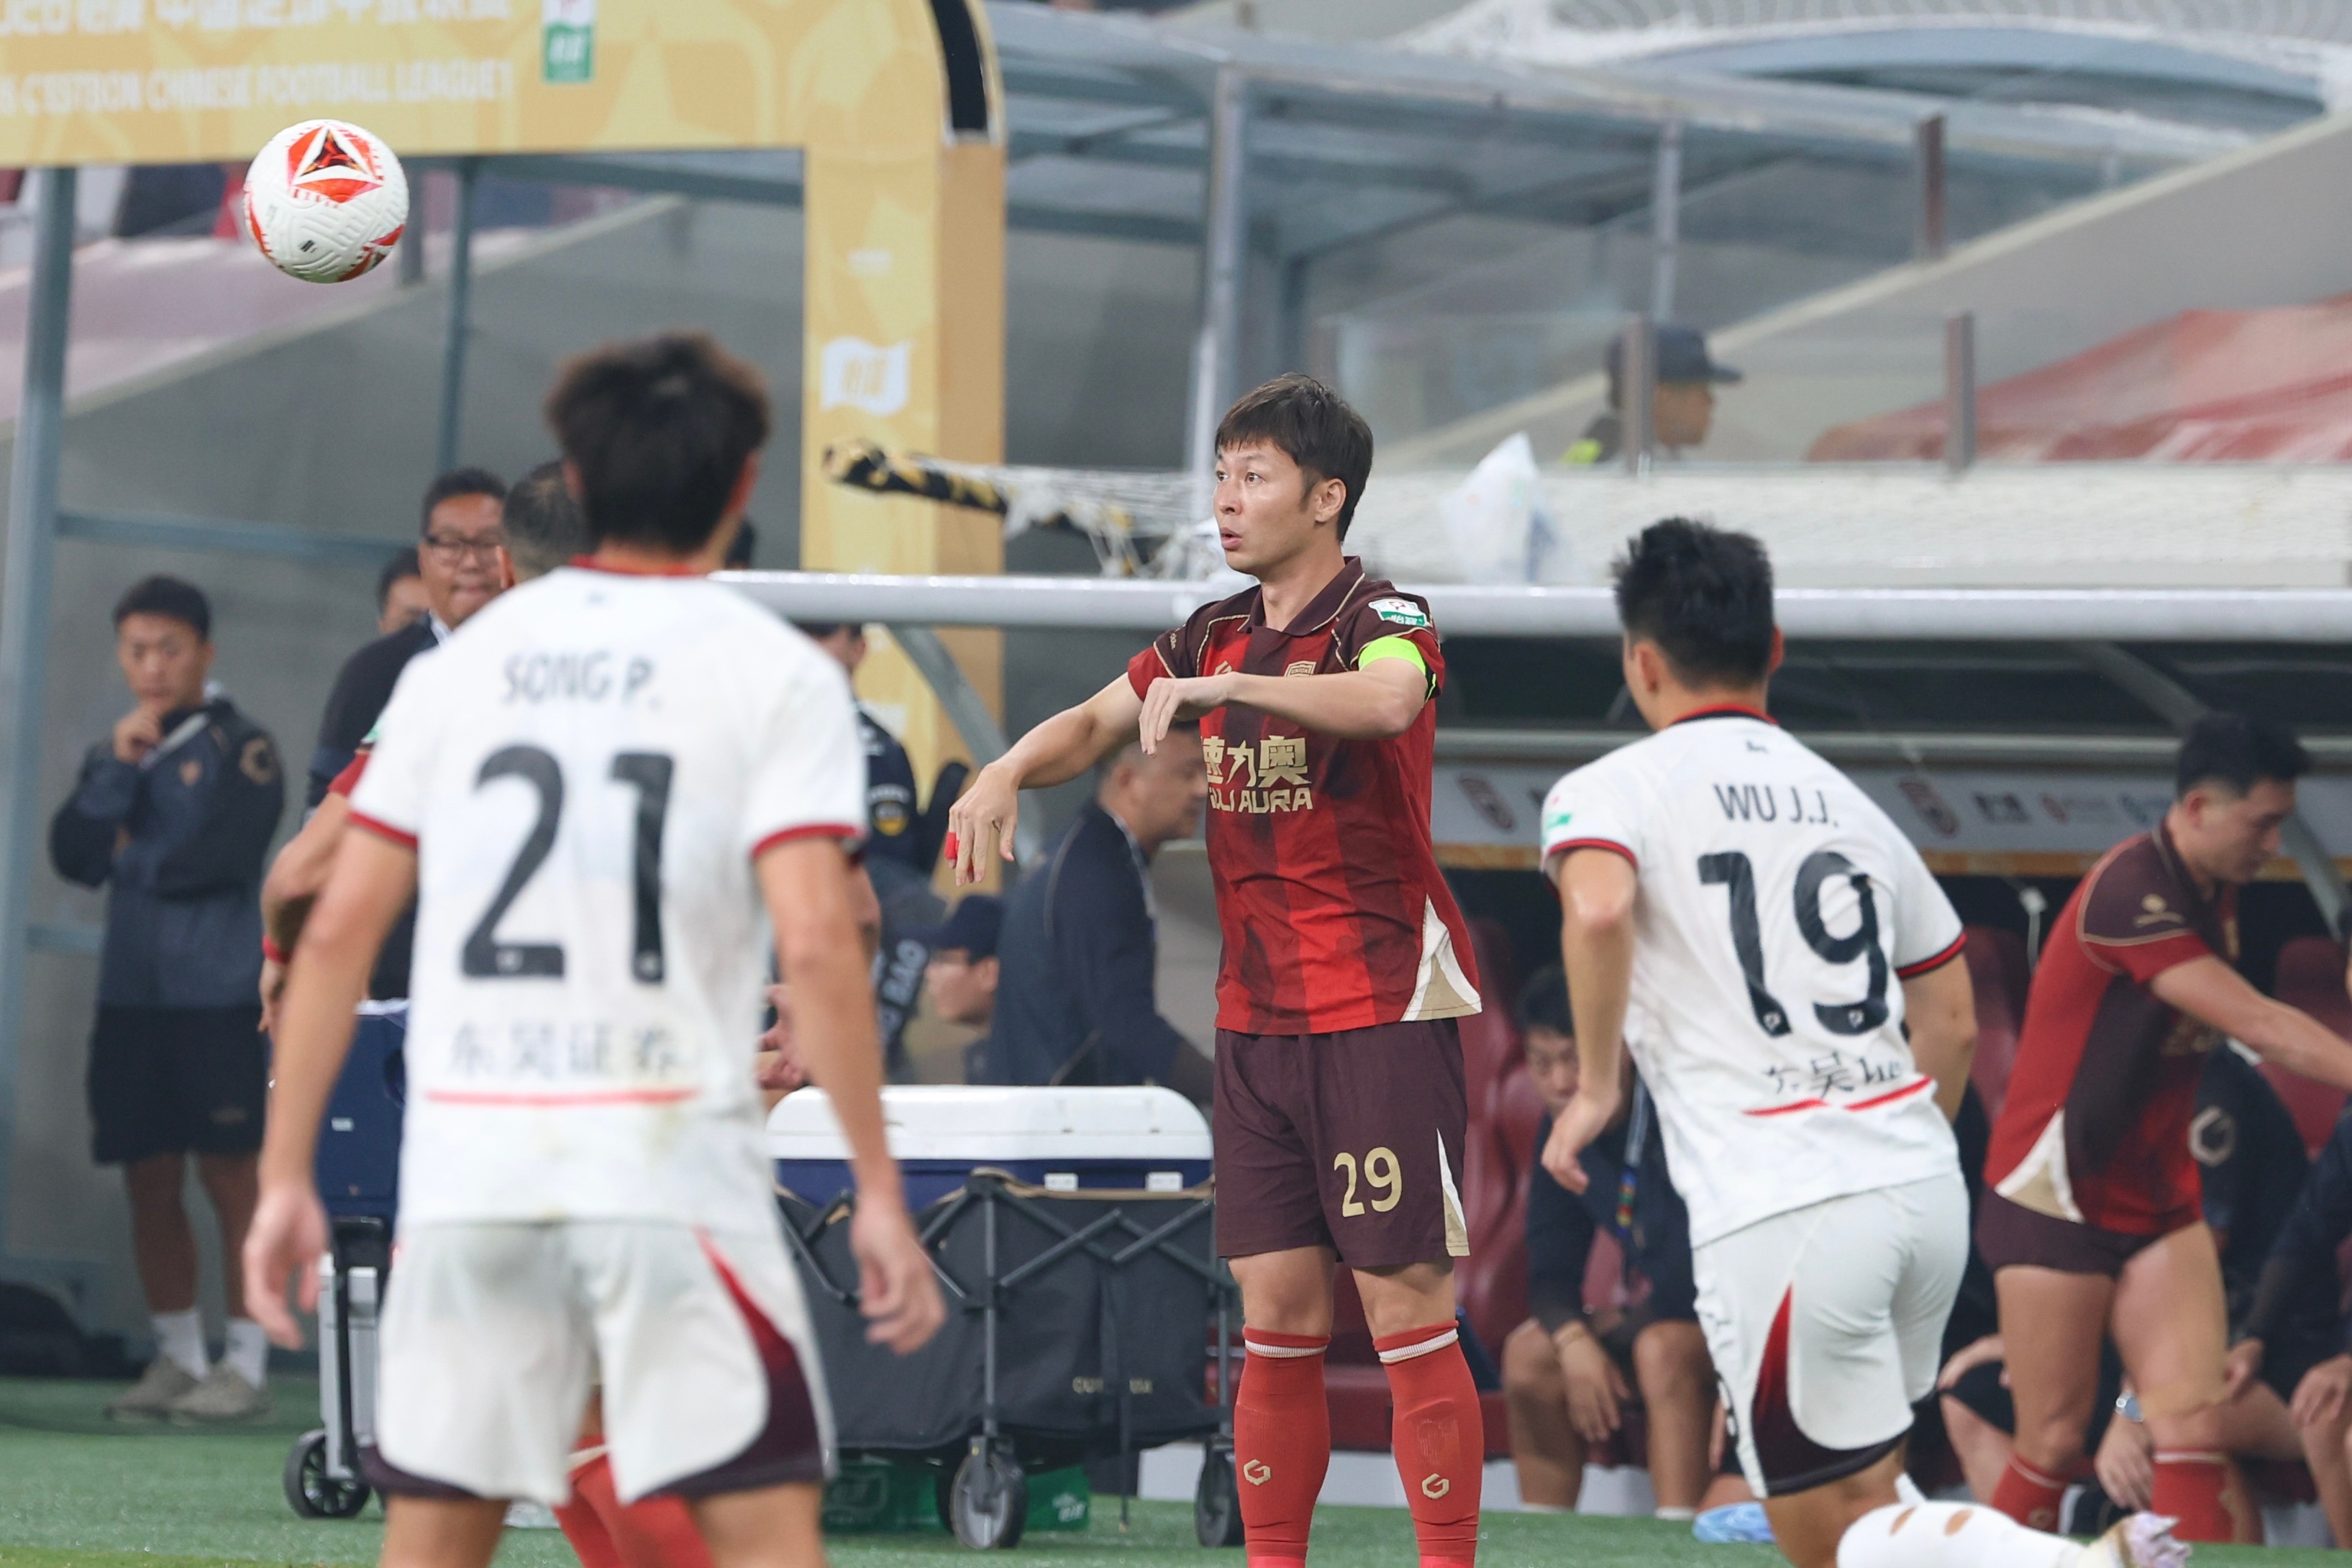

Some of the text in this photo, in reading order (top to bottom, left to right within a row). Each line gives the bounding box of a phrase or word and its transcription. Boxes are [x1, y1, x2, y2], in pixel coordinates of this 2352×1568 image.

[501, 649, 613, 706] SONG
[1238, 788, 1313, 813] AURA
[1714, 783, 1777, 821] WU
[460, 744, 674, 983] 21
[1697, 851, 1890, 1037] 19
[1334, 1147, 1402, 1217] 29
